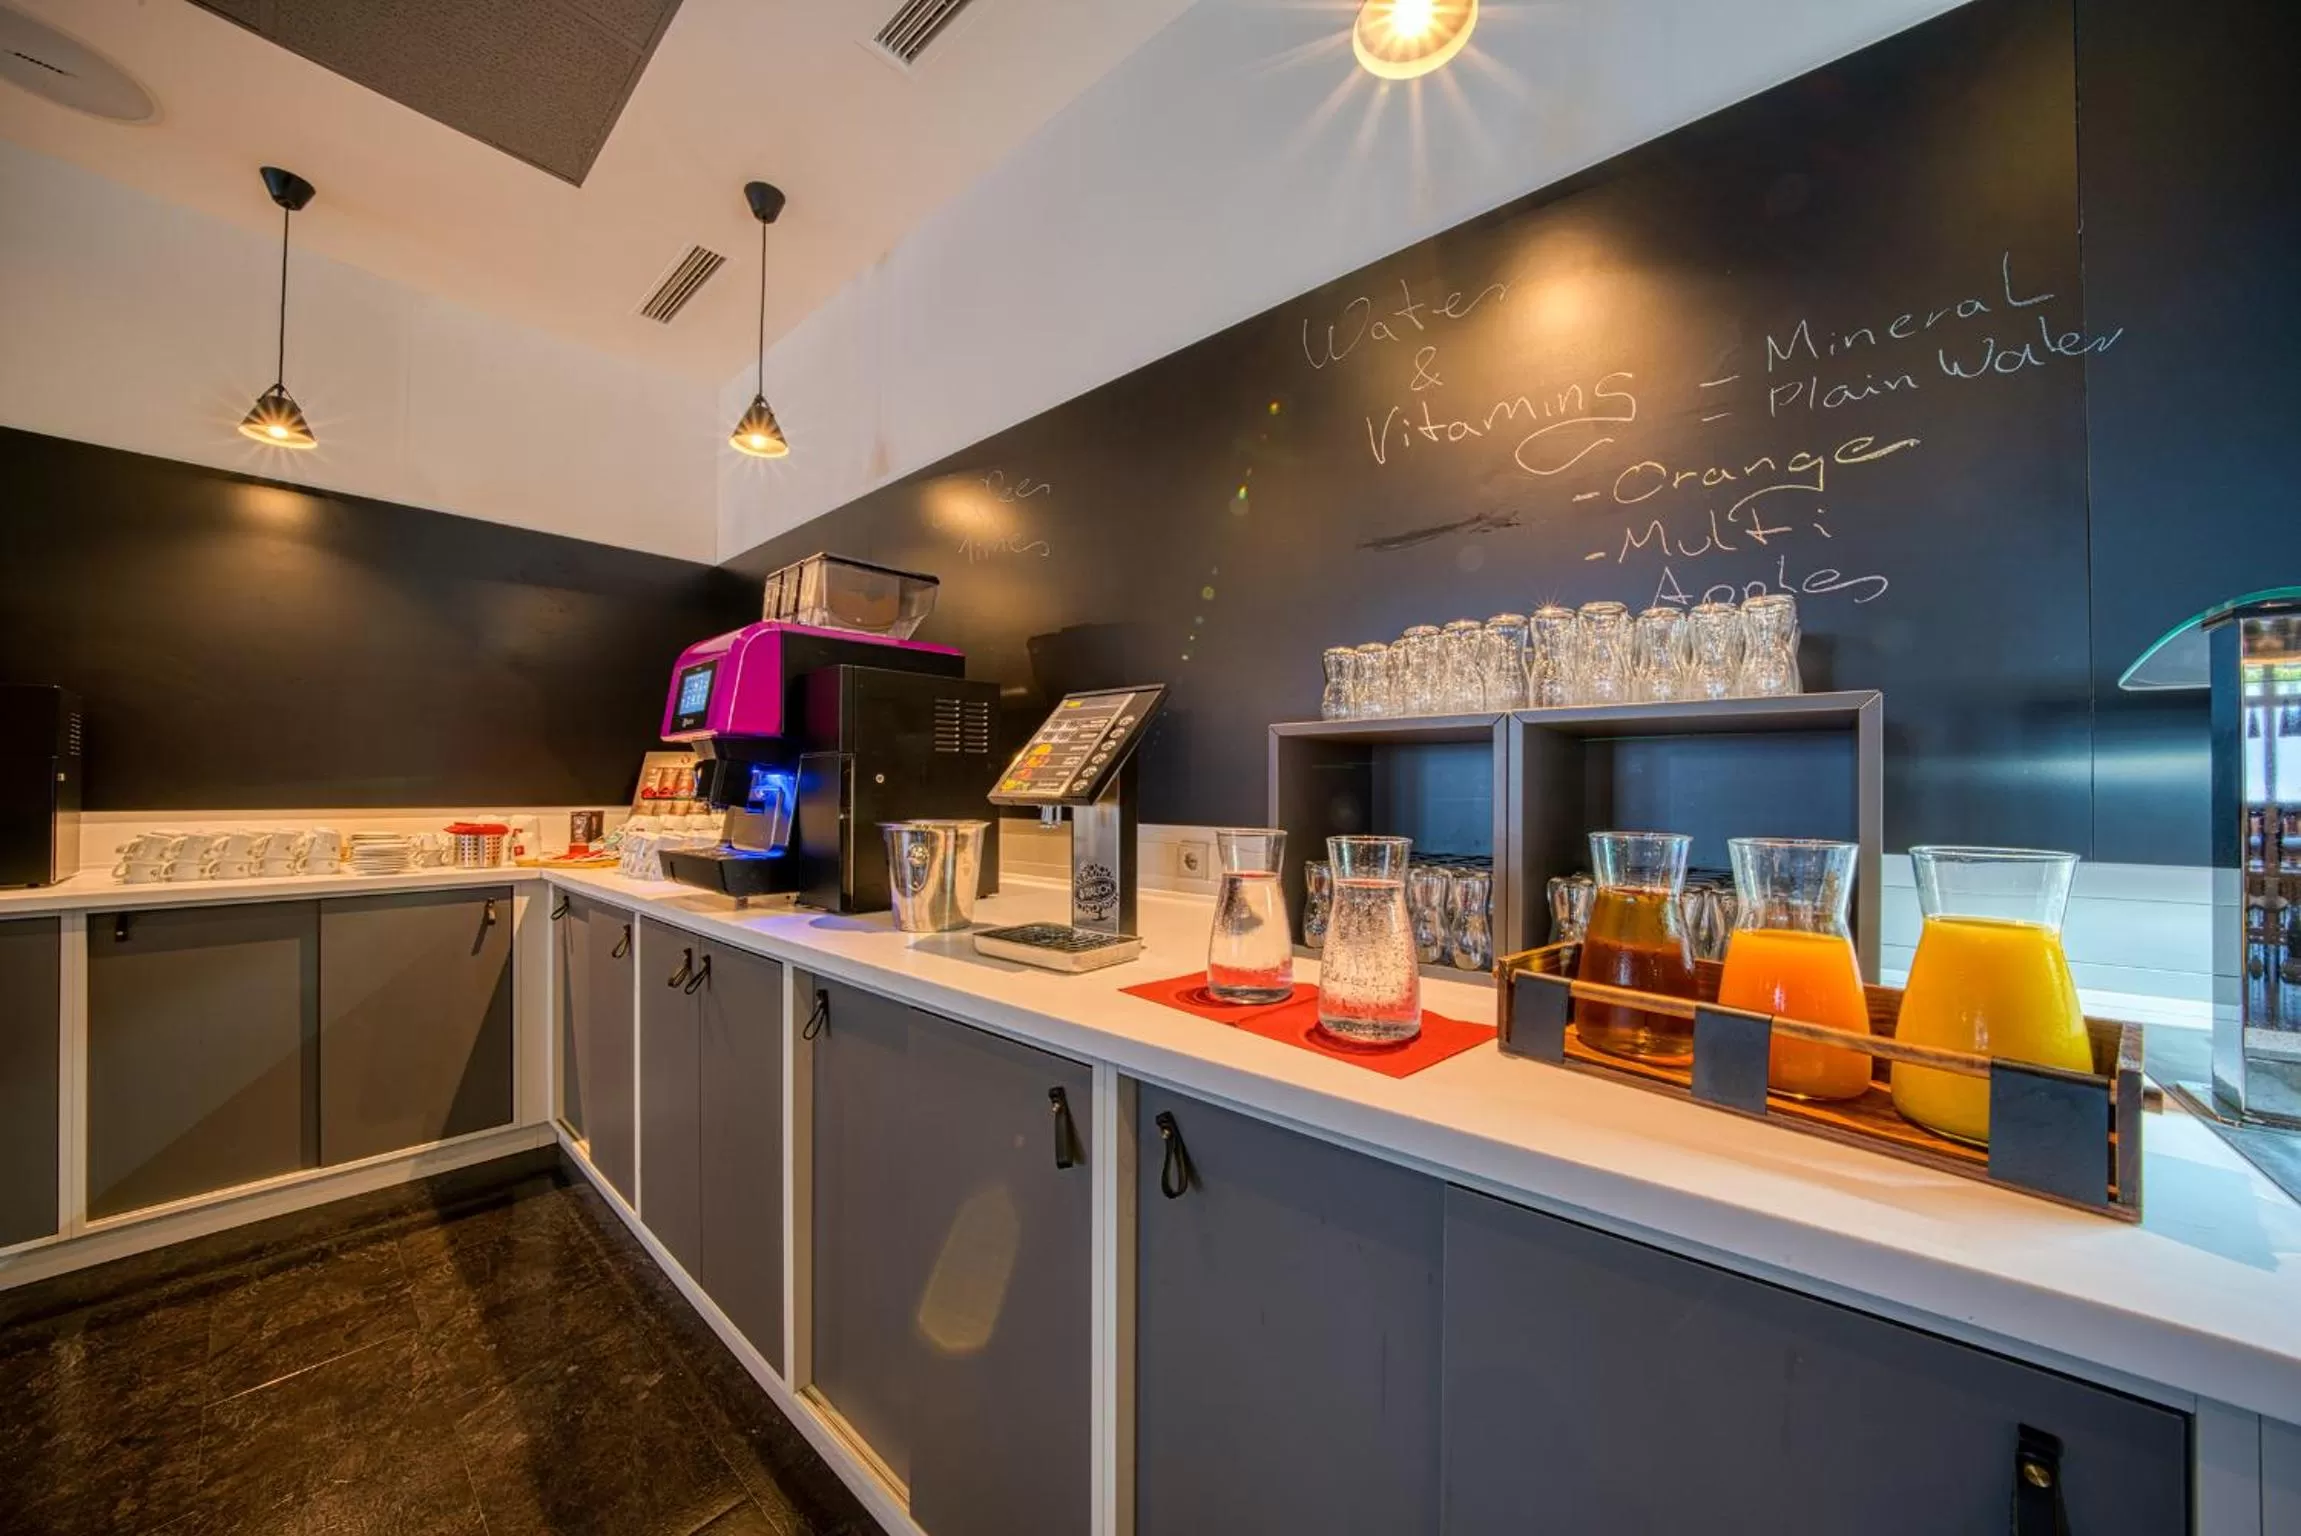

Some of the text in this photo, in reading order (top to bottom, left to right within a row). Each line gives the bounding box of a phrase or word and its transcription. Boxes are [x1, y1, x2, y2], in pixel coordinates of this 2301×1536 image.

[1302, 278, 1511, 370] Water
[1410, 345, 1444, 392] &
[1612, 434, 1921, 522] Orange
